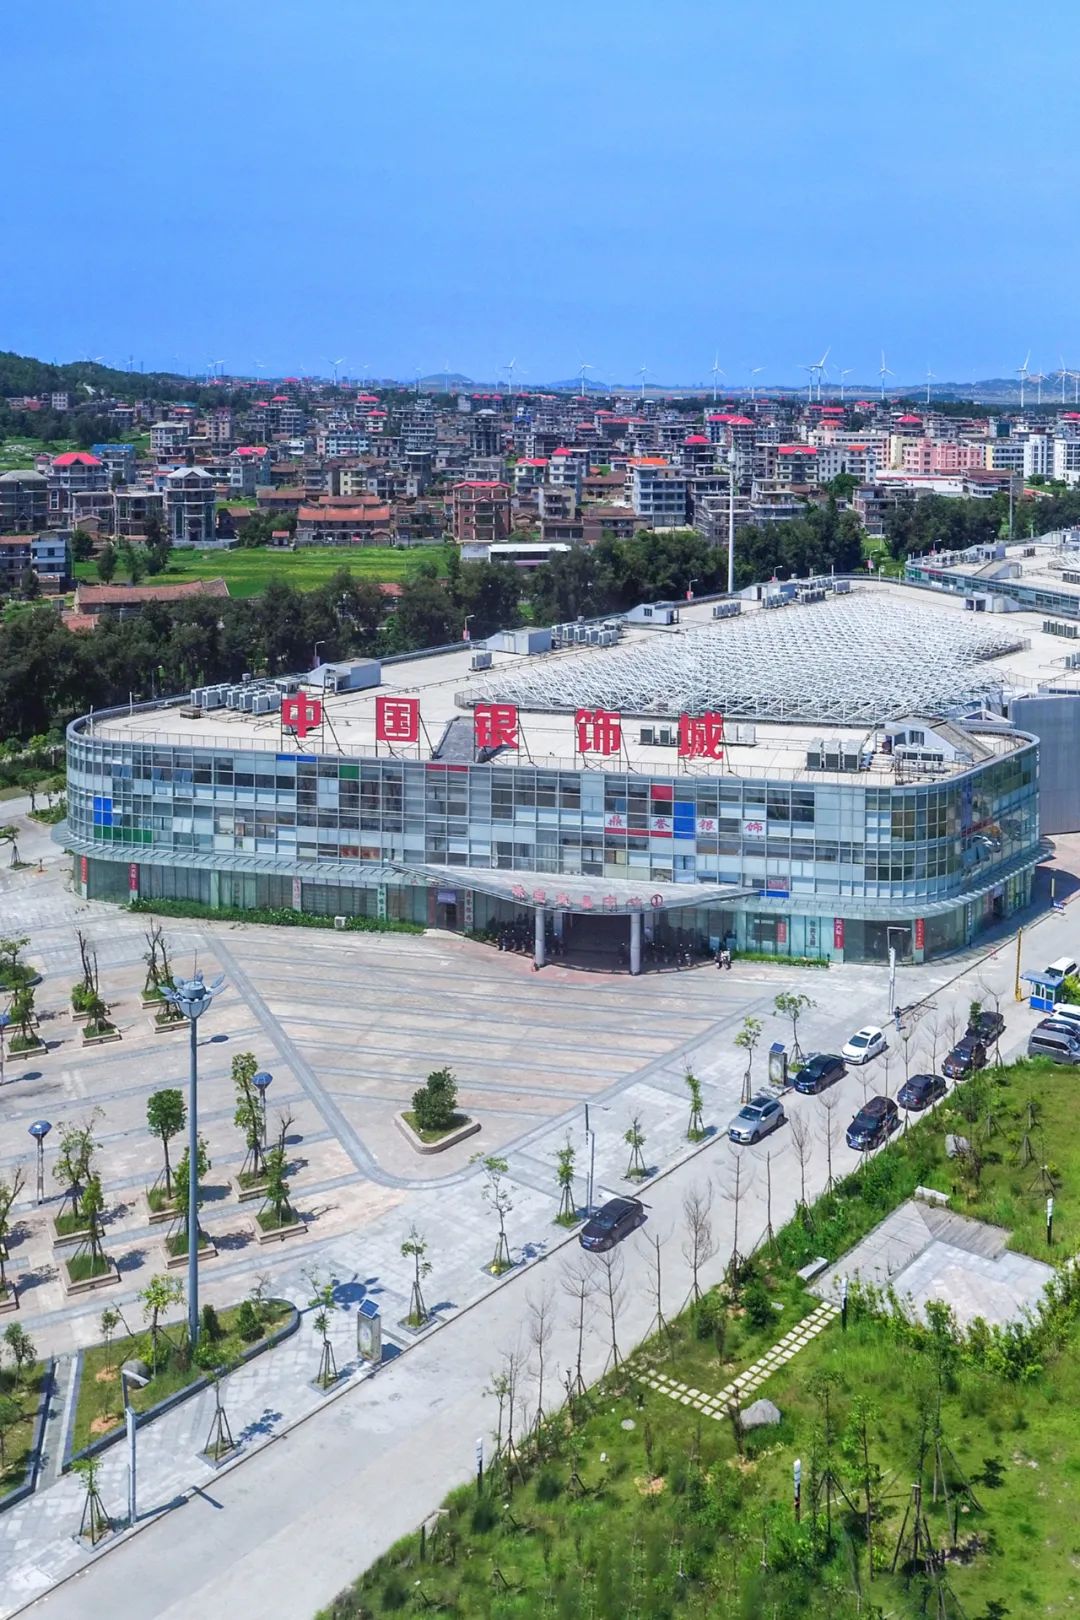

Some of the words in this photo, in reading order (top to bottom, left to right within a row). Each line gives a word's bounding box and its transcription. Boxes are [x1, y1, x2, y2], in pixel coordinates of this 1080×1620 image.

[281, 691, 724, 760] 中国银饰城
